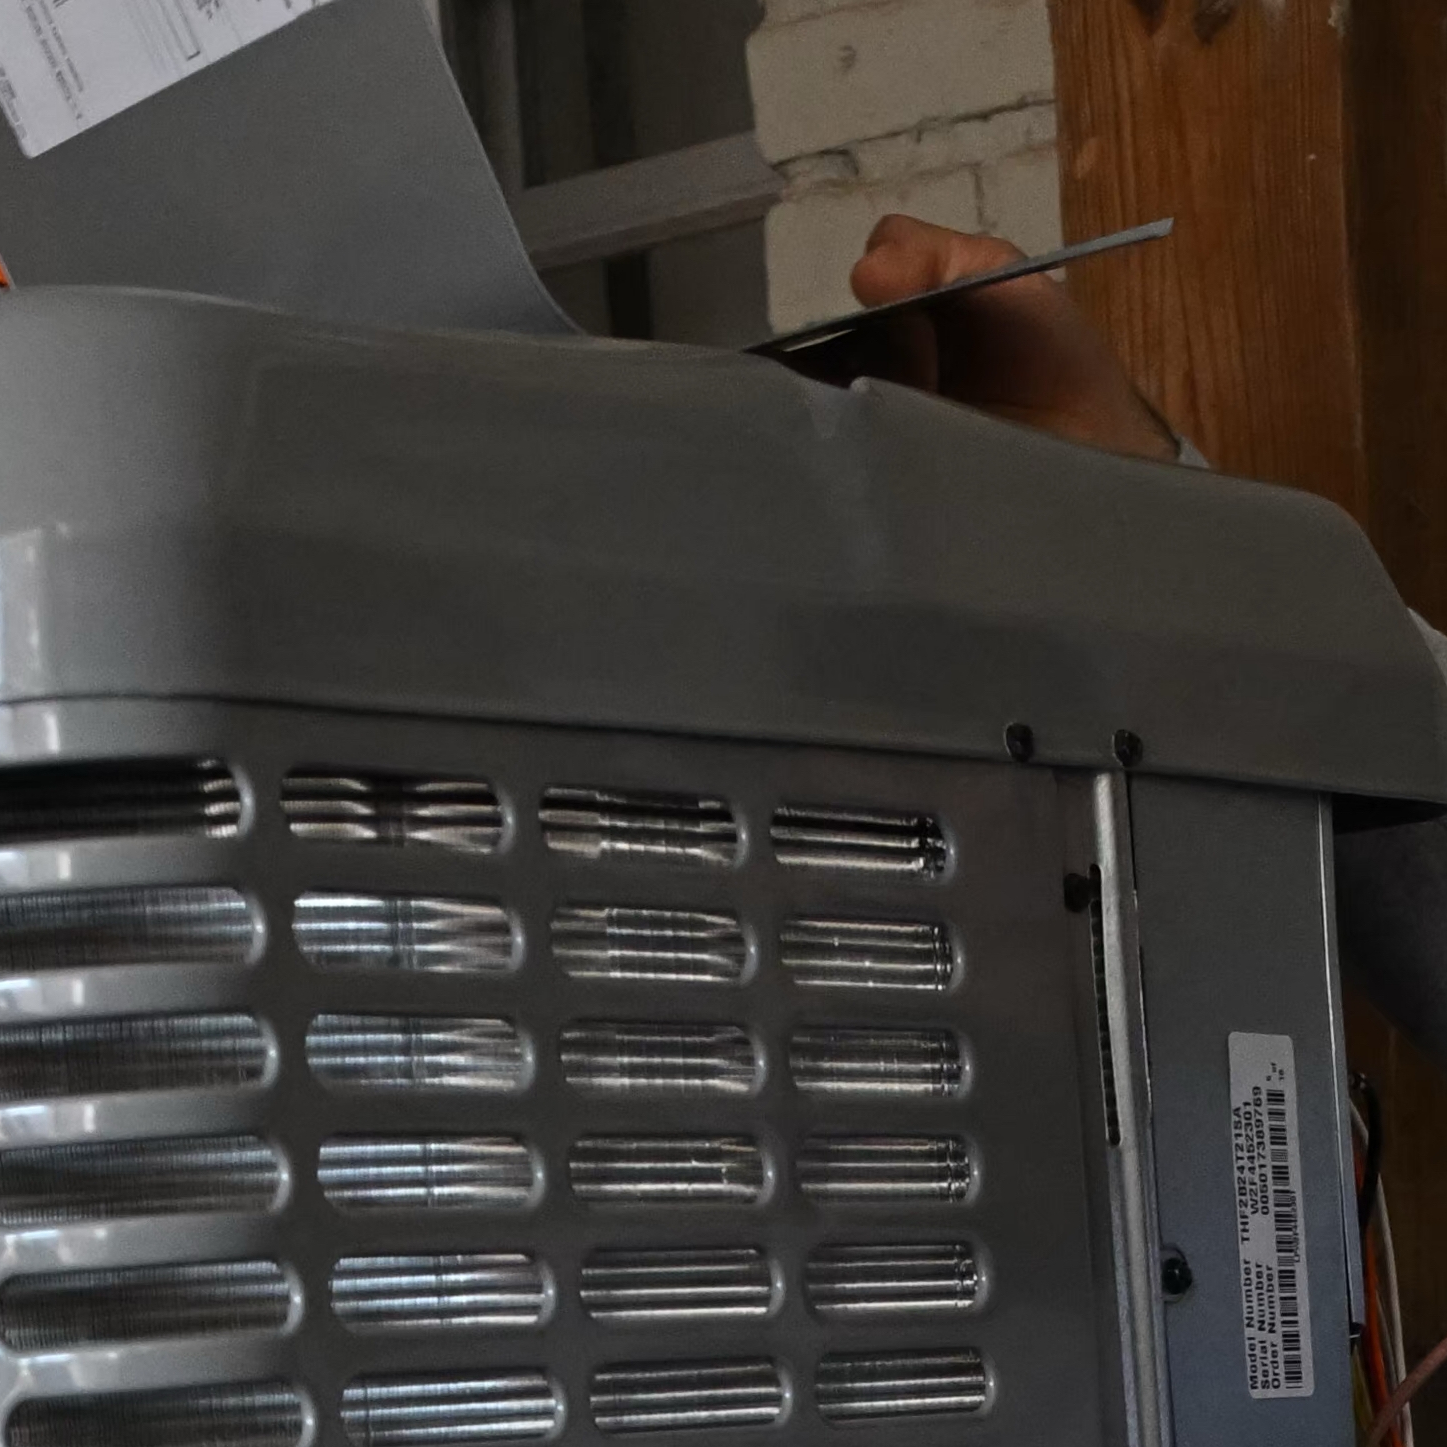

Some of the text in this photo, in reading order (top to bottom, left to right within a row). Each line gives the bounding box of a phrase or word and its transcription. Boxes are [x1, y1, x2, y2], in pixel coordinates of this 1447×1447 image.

[1243, 1258, 1255, 1329] Number
[1255, 1262, 1267, 1332] Number
[1265, 1264, 1277, 1334] Number
[1246, 1336, 1259, 1390] Model
[1257, 1339, 1271, 1390] Serial
[1269, 1341, 1282, 1390] Order
